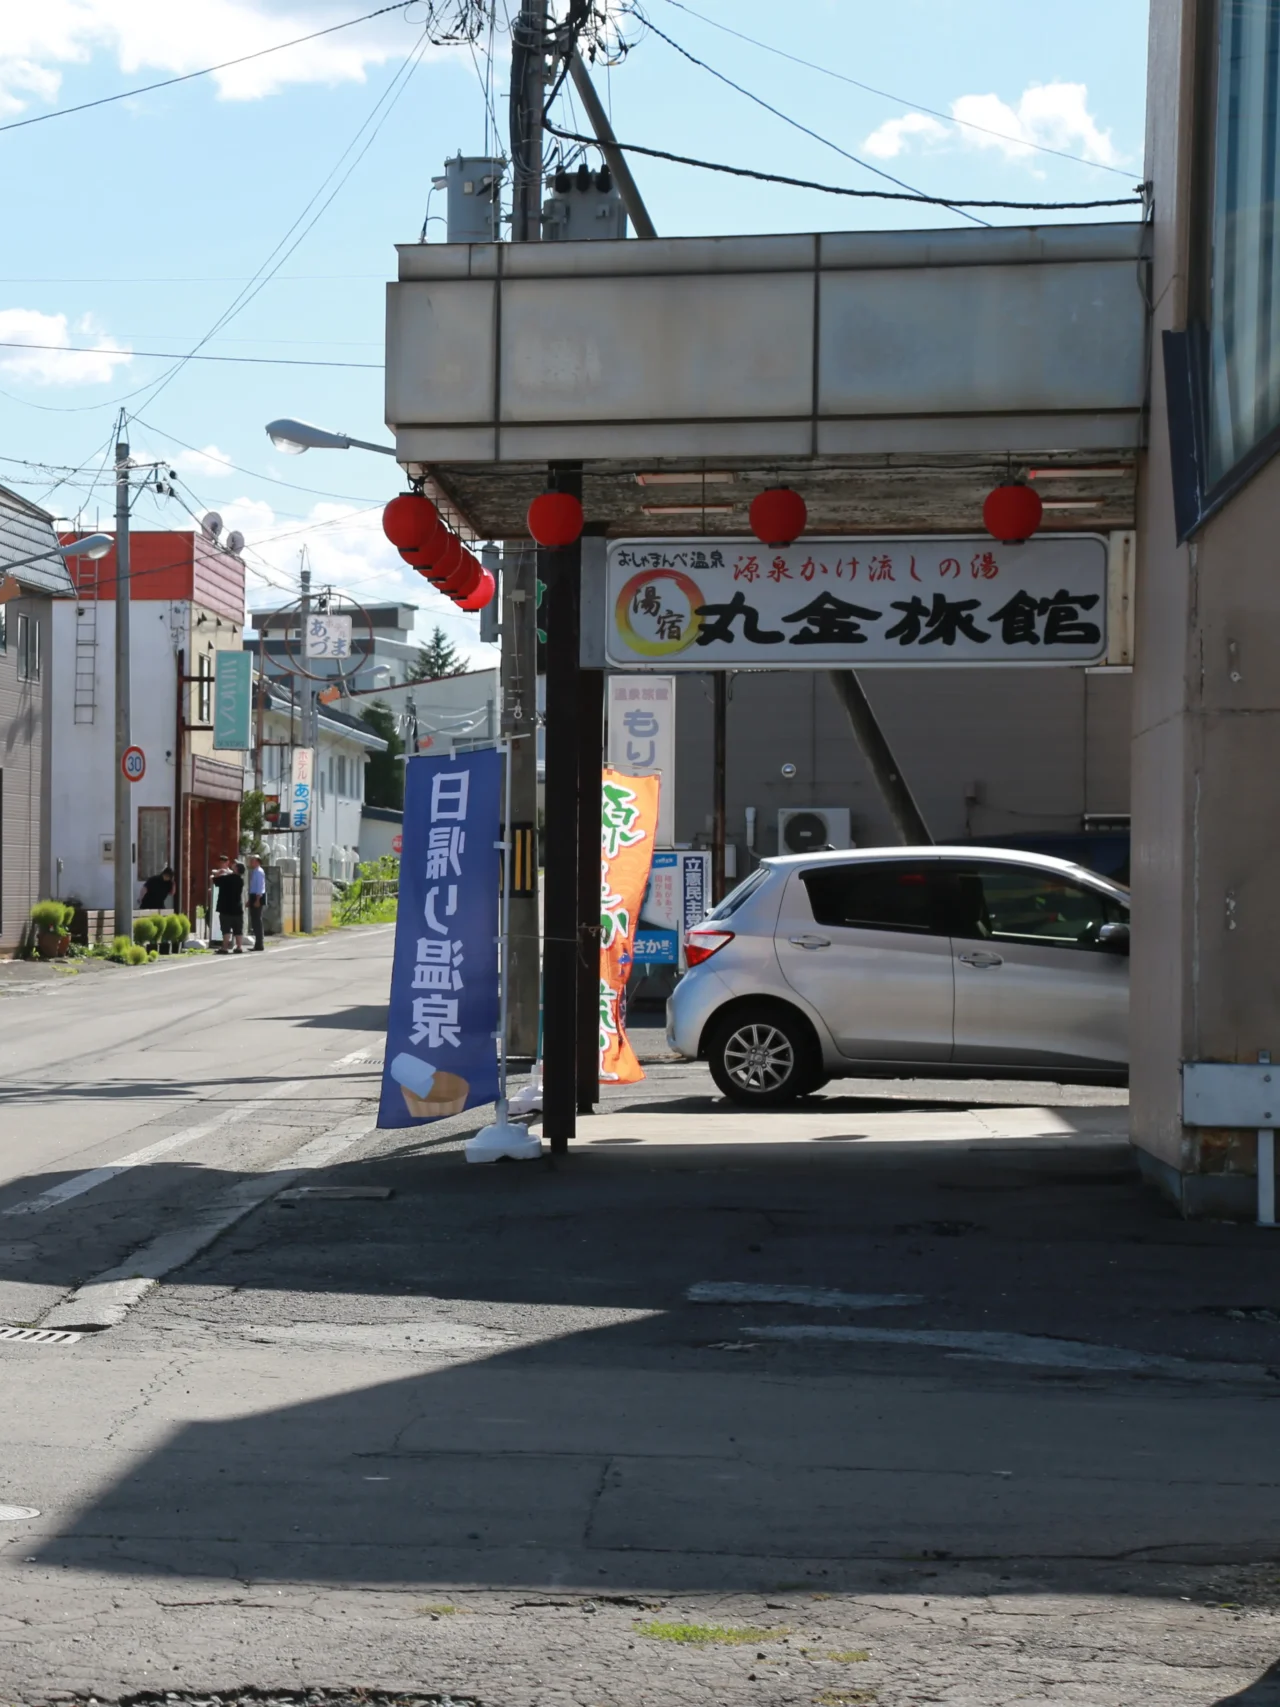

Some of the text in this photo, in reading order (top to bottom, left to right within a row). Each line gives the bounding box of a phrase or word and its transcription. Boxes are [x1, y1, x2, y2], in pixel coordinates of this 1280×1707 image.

[617, 549, 725, 570] おしゃまんべ温泉
[732, 553, 1000, 582] 源泉かけ流しの湯
[631, 586, 684, 642] 湯宿
[695, 589, 1101, 647] 丸金旅館
[127, 756, 142, 772] 30
[623, 708, 660, 776] もり
[293, 751, 310, 827] ホテル あづま
